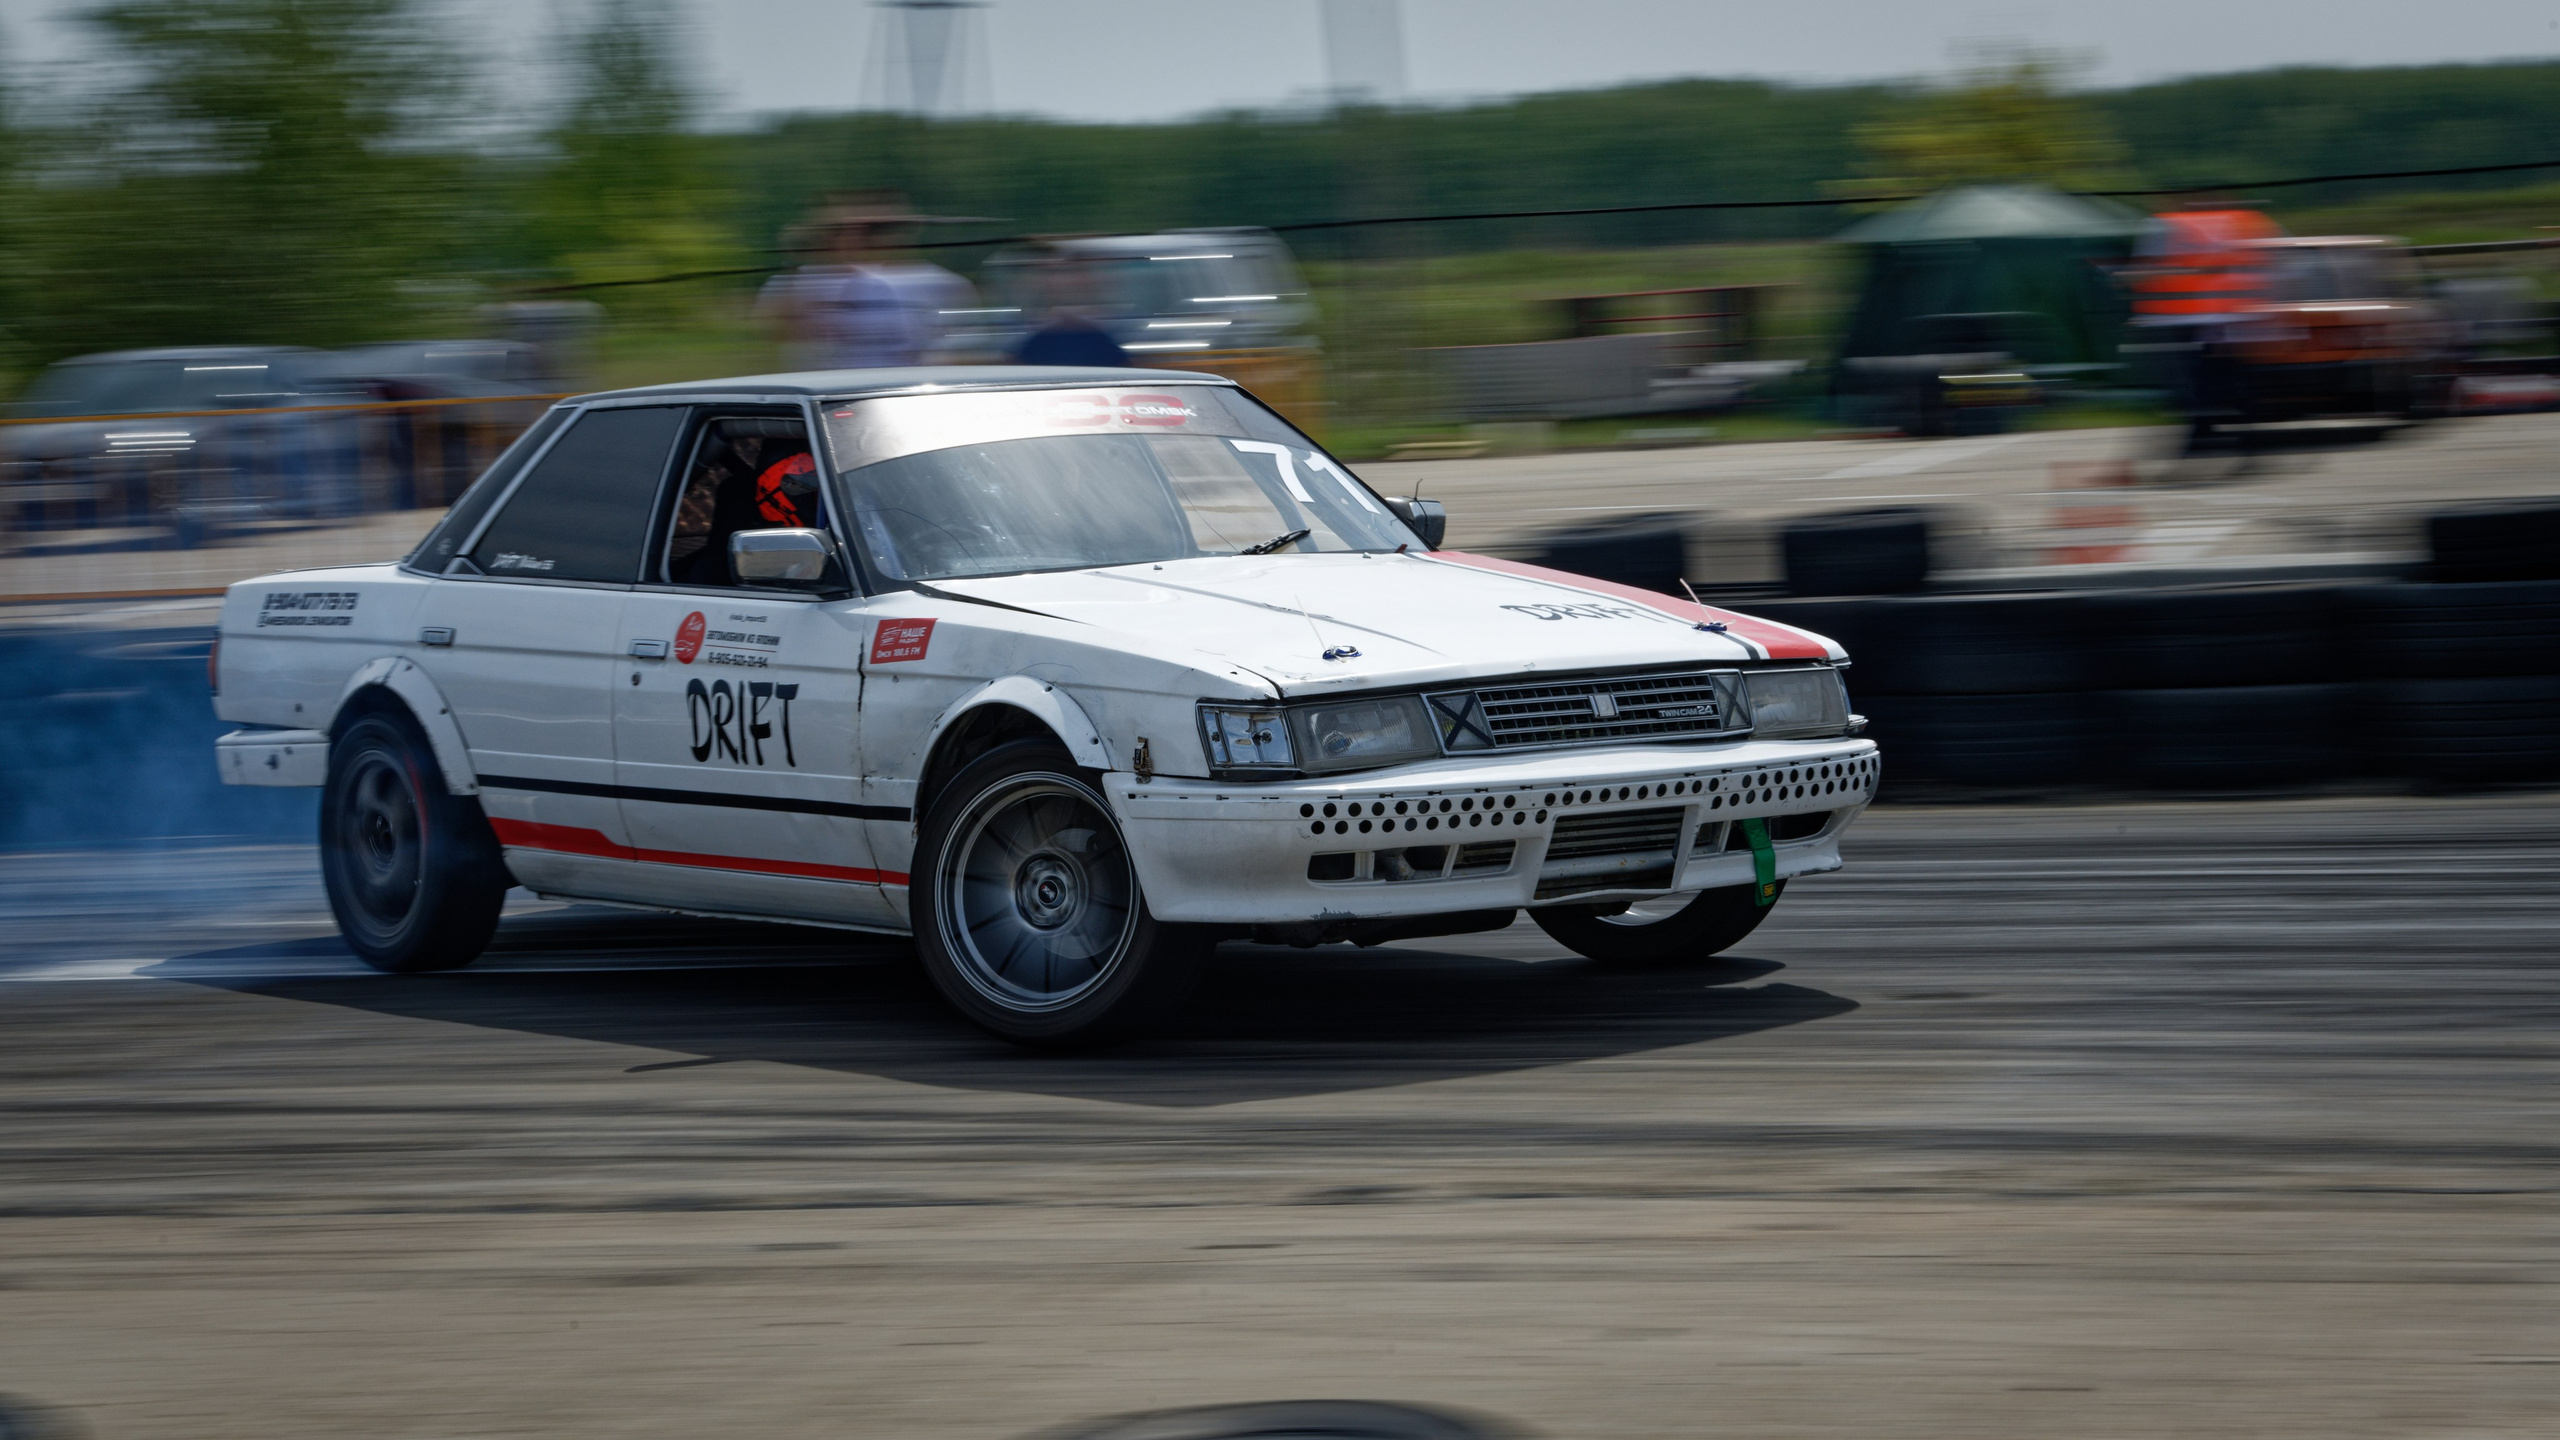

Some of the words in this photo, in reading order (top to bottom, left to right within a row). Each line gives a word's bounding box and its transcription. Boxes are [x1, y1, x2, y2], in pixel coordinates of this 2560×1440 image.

[1229, 439, 1381, 515] 71
[1499, 603, 1668, 624] DRIFT
[706, 629, 746, 644] АВТОМОБИЛИ
[900, 626, 928, 638] НАШЕ
[898, 637, 920, 645] РАДИО
[910, 646, 922, 656] FM
[1659, 709, 1680, 718] TWIN
[1680, 708, 1698, 716] CAM
[1697, 705, 1714, 715] 24
[686, 678, 800, 768] DRIFT
